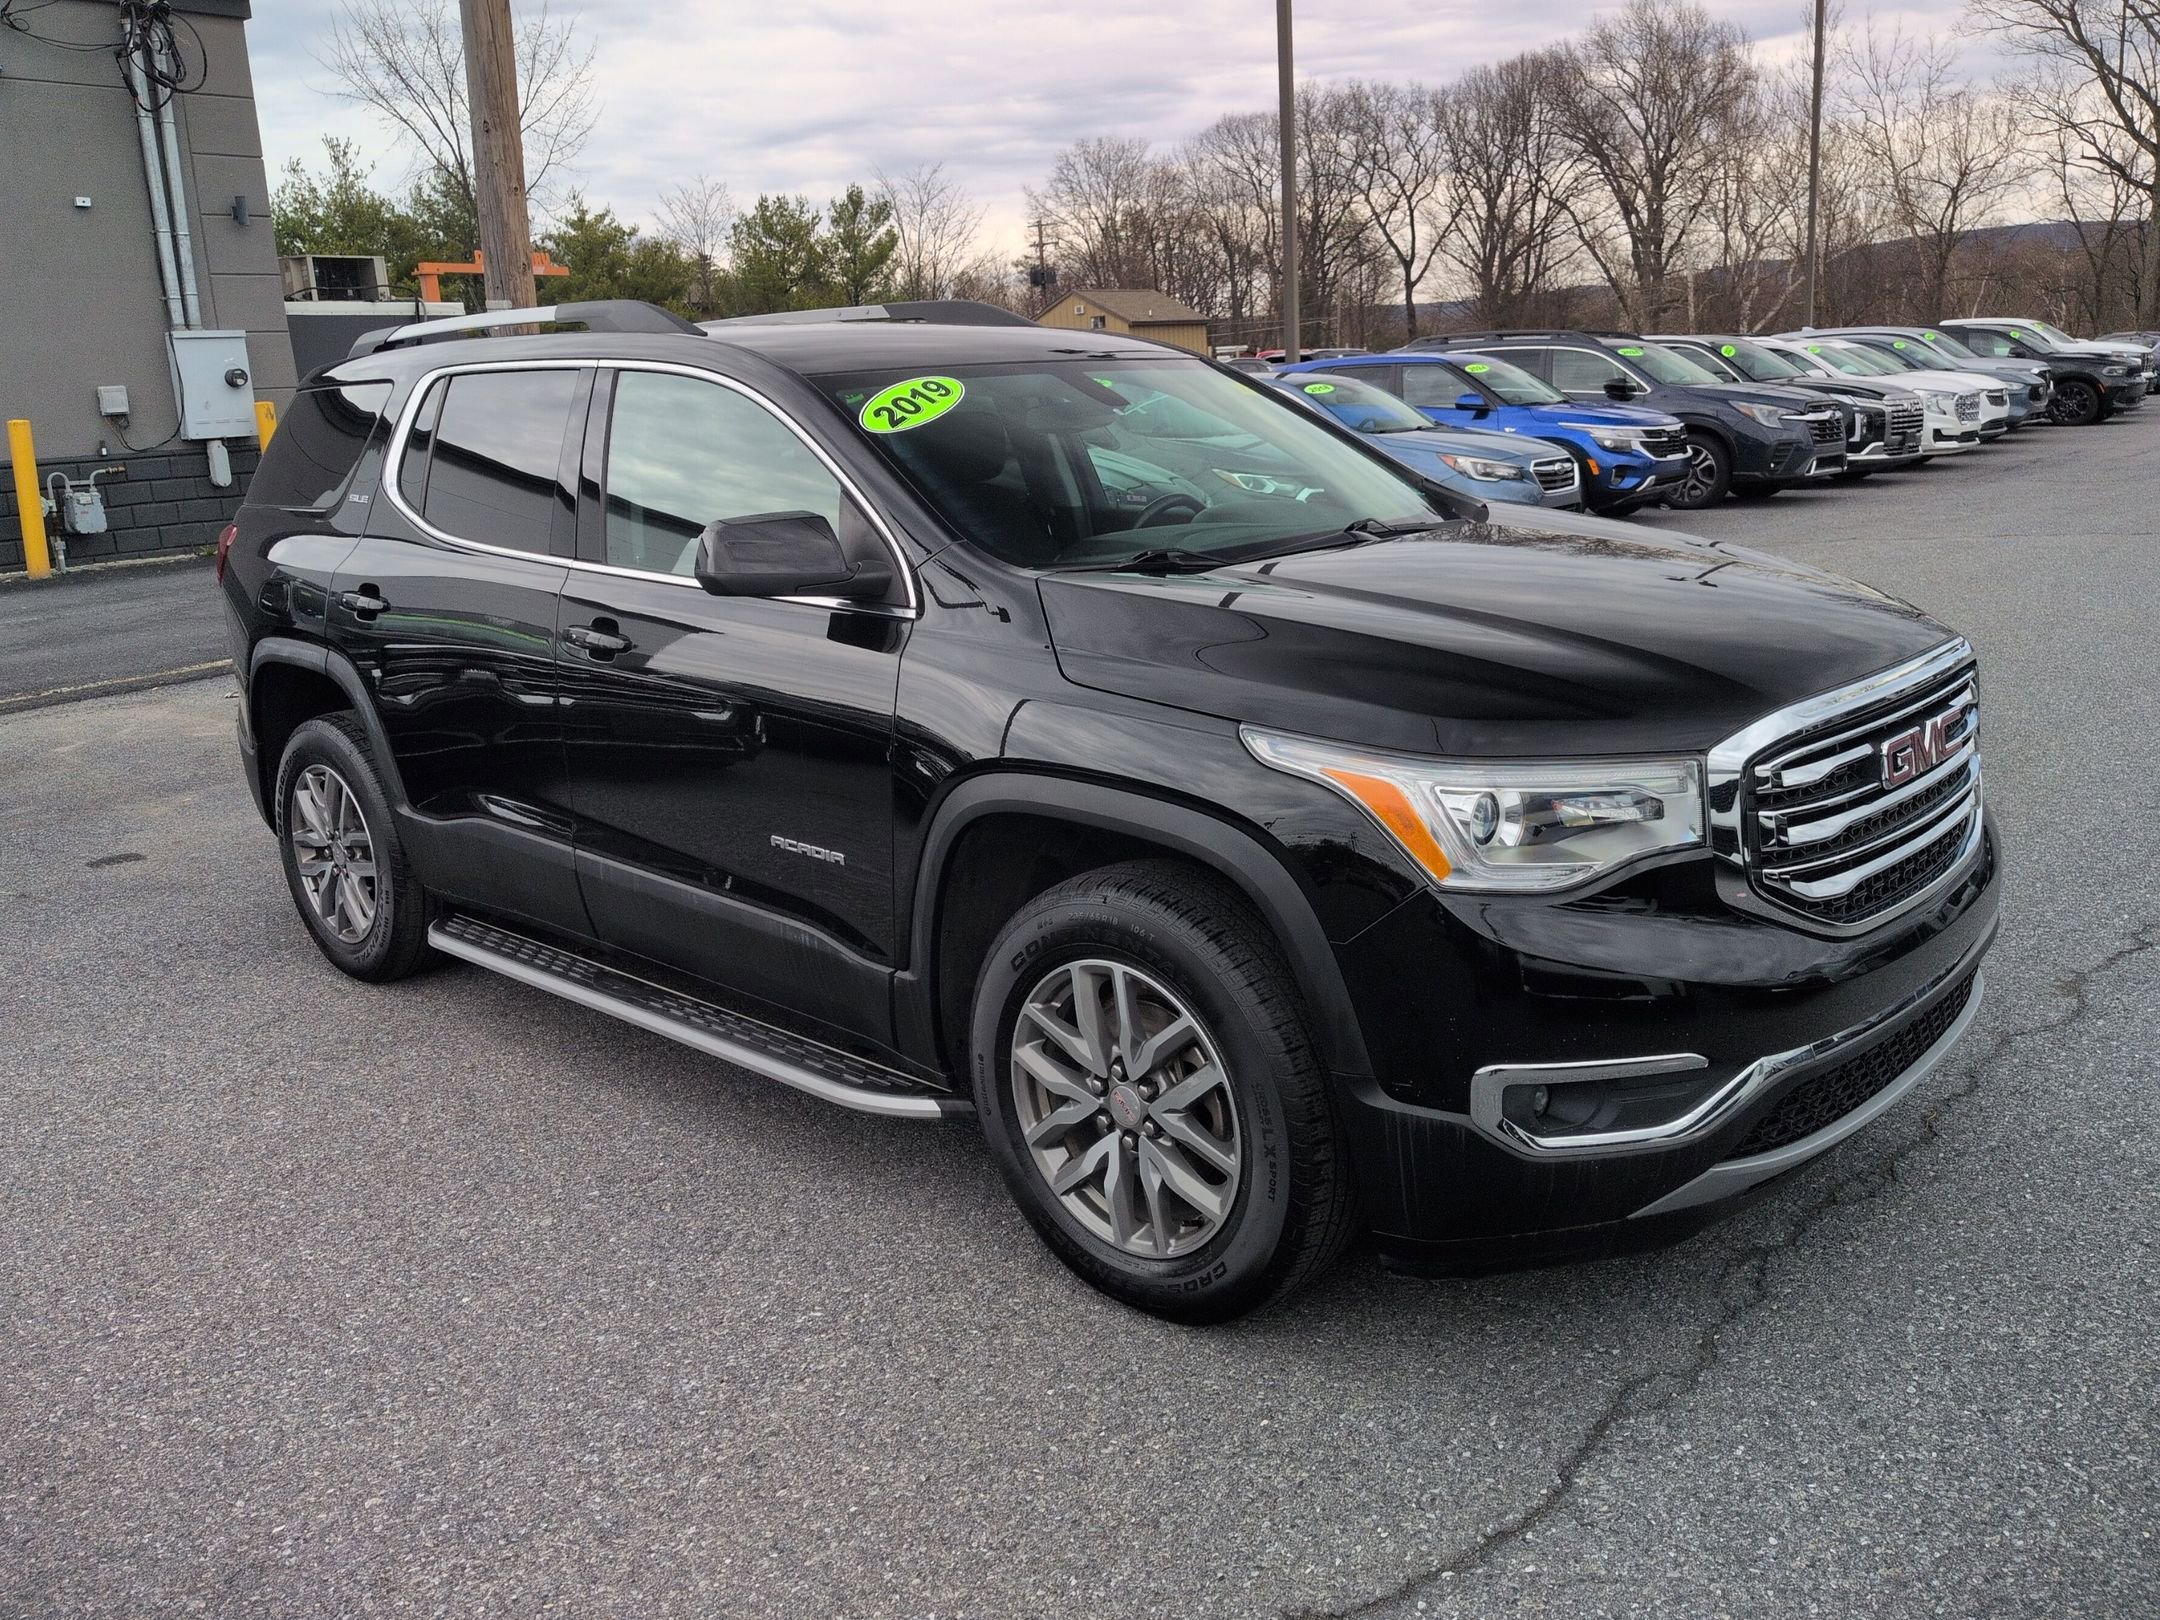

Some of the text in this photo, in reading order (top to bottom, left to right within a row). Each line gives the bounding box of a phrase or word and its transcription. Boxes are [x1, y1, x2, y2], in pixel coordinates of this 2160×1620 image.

[872, 380, 953, 429] 2019
[1880, 708, 1963, 790] GMC
[770, 834, 846, 866] ACADIA
